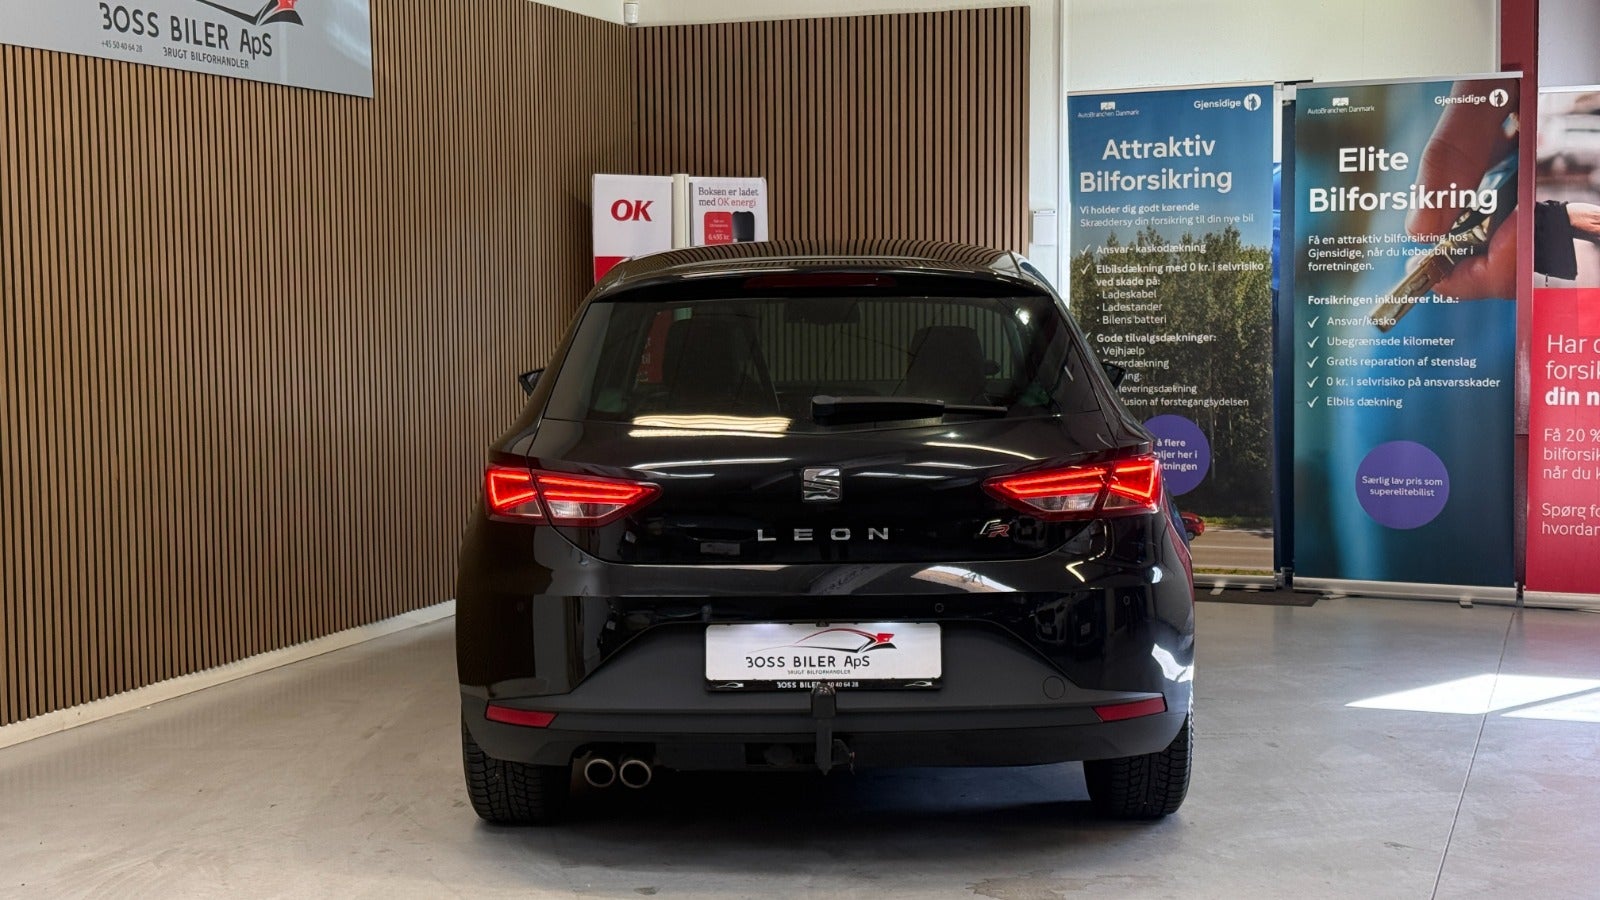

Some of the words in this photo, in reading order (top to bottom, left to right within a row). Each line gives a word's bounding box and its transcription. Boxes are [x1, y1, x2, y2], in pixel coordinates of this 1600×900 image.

[171, 16, 230, 50] BILER
[240, 29, 273, 60] ApS
[190, 51, 249, 69] BILFORHANDLER
[1193, 99, 1242, 110] Gjensidige
[1434, 95, 1487, 106] Gjensidige
[1115, 109, 1140, 117] Danmark
[1348, 105, 1375, 113] Danmark
[1101, 134, 1216, 161] Attraktiv
[1338, 146, 1409, 173] Elite
[1080, 166, 1233, 194] Bilforsikring
[698, 187, 727, 196] Boksen
[699, 198, 716, 207] med
[717, 198, 730, 207] OK
[731, 199, 757, 209] energi
[1309, 182, 1498, 215] Bilforsikring
[610, 199, 654, 222] OK
[1080, 205, 1090, 215] Vi
[1091, 205, 1120, 215] holder
[1122, 204, 1137, 215] dig
[1139, 204, 1160, 215] godt
[1161, 203, 1200, 212] kørende
[1080, 217, 1132, 228] Skræddersy
[1135, 216, 1149, 226] din
[1151, 215, 1194, 226] forsikring
[1195, 214, 1206, 224] til
[1207, 213, 1222, 223] din
[1223, 215, 1240, 225] nye
[1242, 213, 1254, 223] bil
[1308, 234, 1320, 245] Få
[1337, 234, 1382, 244] attraktiv
[1384, 233, 1447, 244] bilforsikring
[1448, 233, 1468, 242] hos
[1096, 246, 1134, 255] Ansvar-
[1135, 243, 1207, 255] kaskodækning
[1308, 248, 1365, 260] Gjensidige,
[1367, 246, 1384, 257] når
[1386, 247, 1400, 257] du
[1402, 247, 1432, 256] køber
[1434, 246, 1447, 256] bil
[1449, 246, 1468, 256] her
[1470, 246, 1474, 255] i
[1096, 263, 1164, 275] Elbilsdækning
[1165, 262, 1187, 272] med
[1189, 263, 1196, 272] 0
[1198, 262, 1211, 272] kr.
[1217, 261, 1264, 271] selvrisiko
[1308, 261, 1375, 273] forretningen.
[1096, 277, 1114, 286] ved
[1115, 277, 1144, 286] skade
[1146, 276, 1161, 288] på:
[1102, 289, 1157, 299] Ladeskabel
[1308, 295, 1373, 307] Forsikringen
[1375, 294, 1430, 304] inkluderer
[1432, 294, 1459, 304] bl.a.:
[1102, 302, 1163, 312] Ladestander
[1102, 315, 1132, 325] Bilens
[1134, 314, 1167, 324] batteri
[1327, 315, 1397, 327] Ansvar/kasko
[1096, 333, 1123, 343] Gode
[1125, 333, 1217, 344] tilvalgsdækninger:
[1327, 336, 1401, 348] Ubegrænsede
[1403, 336, 1455, 346] kilometer
[1547, 334, 1587, 354] Har
[1102, 346, 1146, 357] Vejhjælp
[1326, 356, 1358, 367] Gratis
[1360, 357, 1415, 369] reparation
[1417, 356, 1429, 366] af
[1430, 357, 1477, 369] stenslag
[1326, 377, 1333, 386] 0
[1335, 377, 1349, 386] kr.
[1356, 377, 1406, 387] selvrisiko
[1407, 377, 1422, 389] på
[1423, 378, 1500, 388] ansvarsskader
[1149, 397, 1159, 406] af
[1160, 396, 1249, 408] førstegangsydelsen
[1545, 386, 1580, 406] din
[1326, 397, 1355, 407] Elbils
[1357, 397, 1403, 409] dækning
[1544, 427, 1561, 442] Få
[1566, 428, 1586, 442] 20
[1164, 438, 1186, 447] flere
[1177, 450, 1192, 459] her
[1543, 466, 1568, 480] når
[1572, 467, 1591, 480] du
[1362, 475, 1390, 487] Særlig
[1391, 477, 1404, 485] lav
[1405, 477, 1423, 487] pris
[1369, 487, 1435, 497] superelitebilist
[1542, 502, 1587, 520] Spørg
[757, 527, 889, 542] LEON
[979, 519, 1010, 538] FR
[793, 655, 836, 668] BILER
[844, 655, 871, 669] ApS
